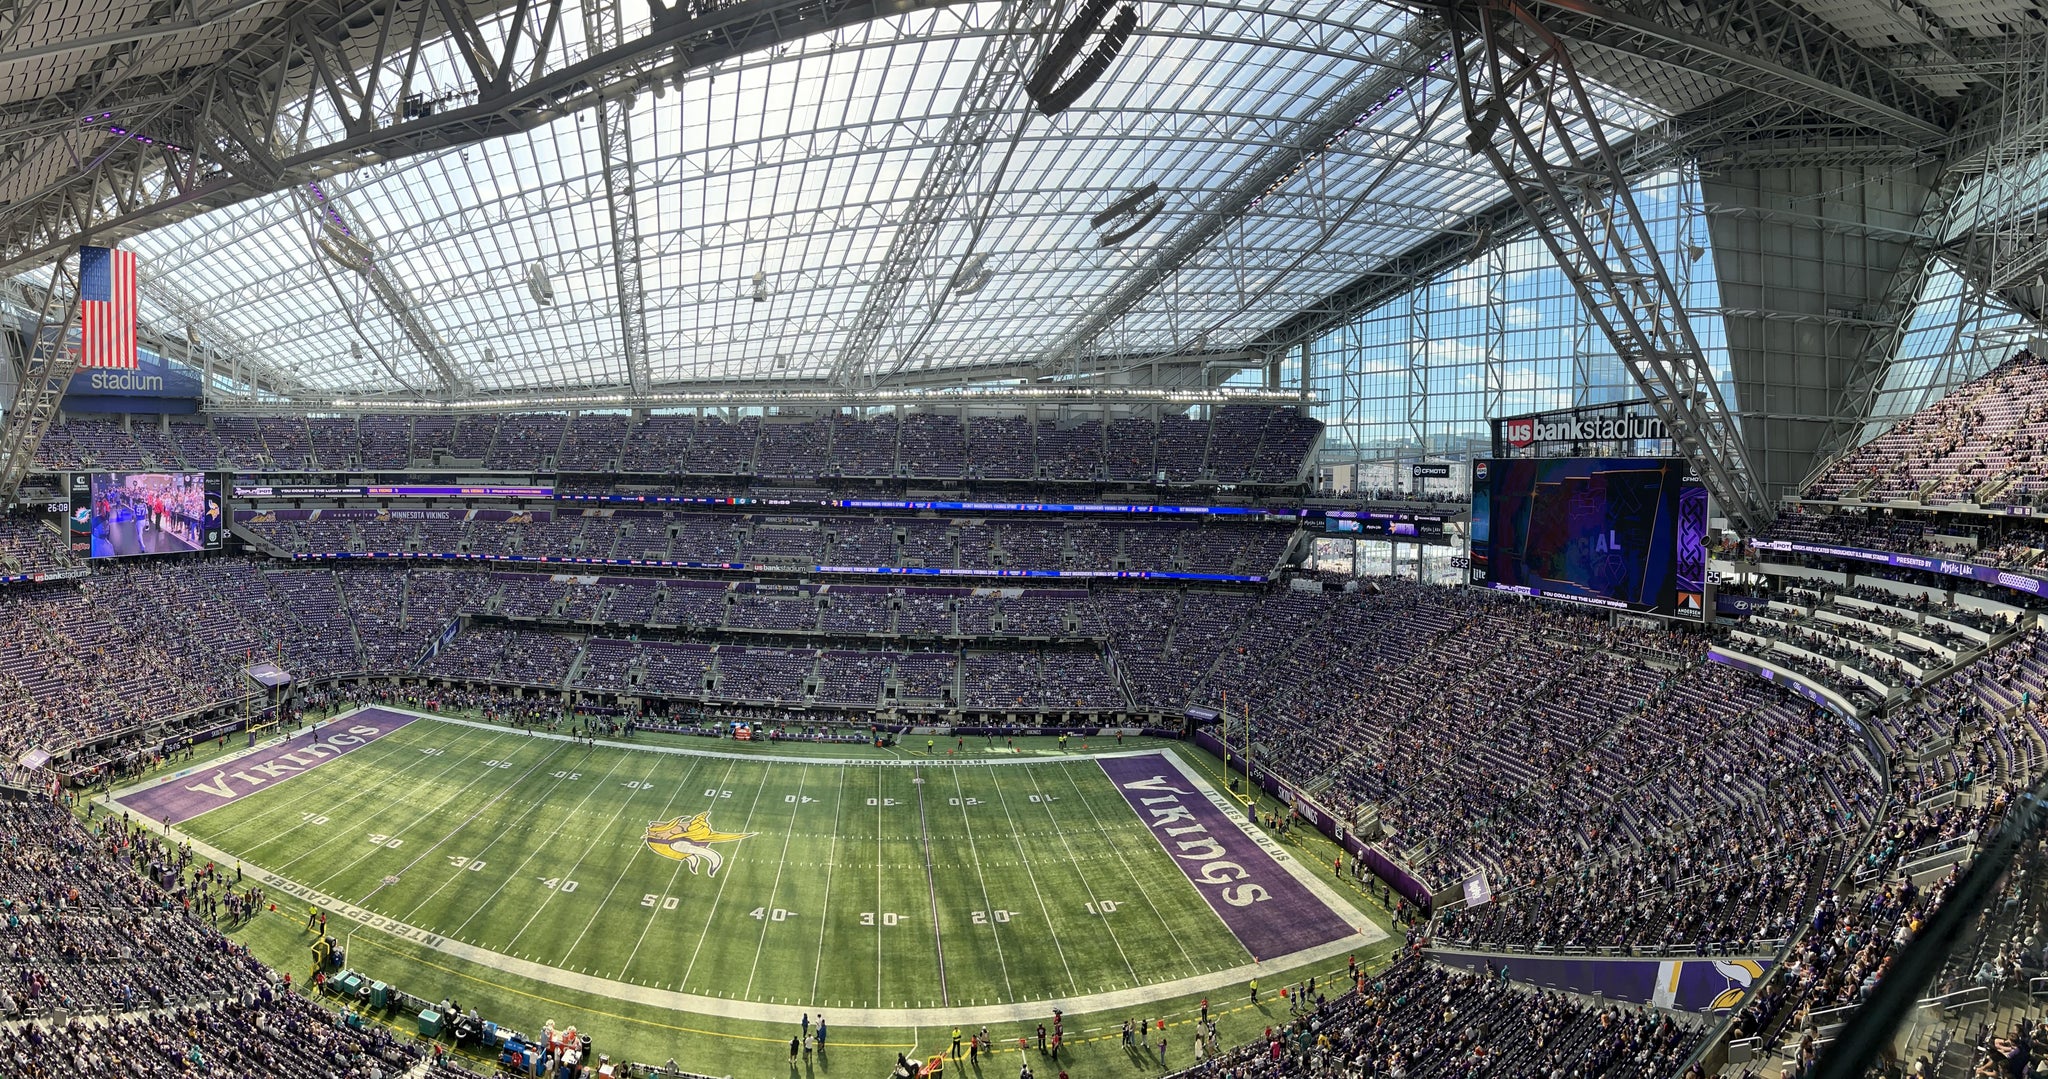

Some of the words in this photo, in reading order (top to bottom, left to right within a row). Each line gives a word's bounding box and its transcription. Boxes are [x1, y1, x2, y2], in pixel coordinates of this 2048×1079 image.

[92, 370, 162, 390] stadium
[48, 503, 68, 512] 26:08
[1896, 556, 1924, 566] PRESENTED
[1472, 567, 1486, 580] Lite
[1708, 572, 1720, 583] 25
[185, 725, 380, 798] VIKINGS
[487, 760, 512, 768] 20
[554, 771, 582, 780] 30
[627, 781, 654, 790] 40
[704, 789, 732, 799] 50
[784, 794, 812, 804] 40
[1029, 794, 1053, 803] 10
[866, 798, 895, 806] 30
[948, 797, 977, 806] 20
[1204, 790, 1218, 799] IT
[1213, 797, 1242, 820] TAKES
[1238, 822, 1259, 838] ALL
[1256, 837, 1274, 850] OF
[1271, 849, 1289, 862] US
[369, 834, 404, 848] 20
[1123, 775, 1273, 907] VIKINGS
[450, 857, 486, 871] 30
[544, 878, 579, 893] 40
[641, 894, 680, 910] 50
[1084, 901, 1118, 915] 10
[263, 874, 332, 906] CANCER
[335, 907, 444, 948] INTERCEPT
[749, 907, 788, 922] 40
[972, 910, 1010, 924] 20
[860, 912, 897, 926] 30
